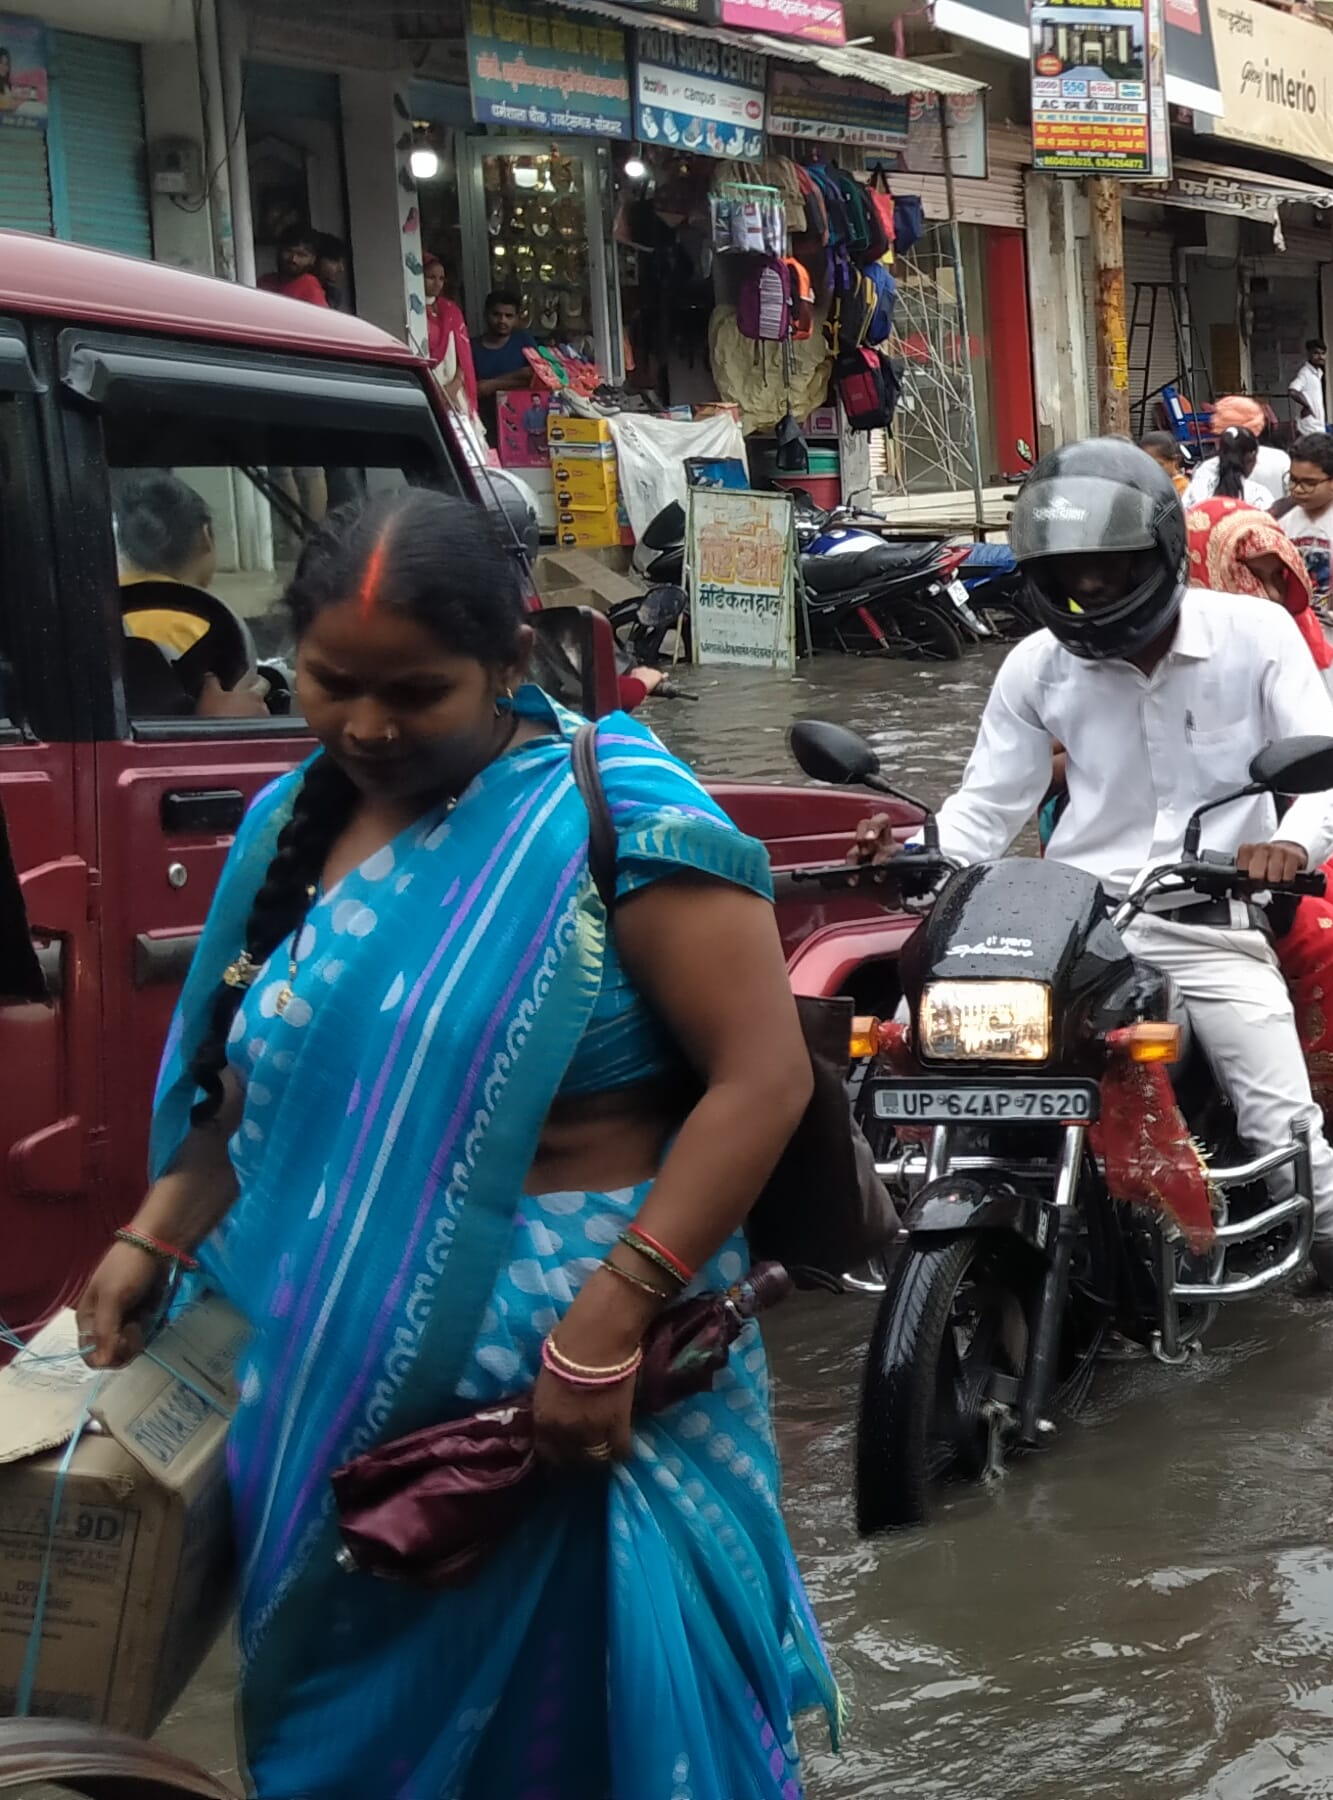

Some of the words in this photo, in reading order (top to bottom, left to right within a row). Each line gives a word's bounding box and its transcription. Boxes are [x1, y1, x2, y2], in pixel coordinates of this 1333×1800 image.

[679, 34, 719, 76] SHOES
[721, 45, 766, 87] CENTER
[1265, 58, 1317, 114] interio
[1041, 100, 1058, 109] AC
[903, 1094, 934, 1116] UP
[947, 1094, 1010, 1116] 64AP
[1023, 1093, 1087, 1116] 7620
[74, 1512, 120, 1544] 9D
